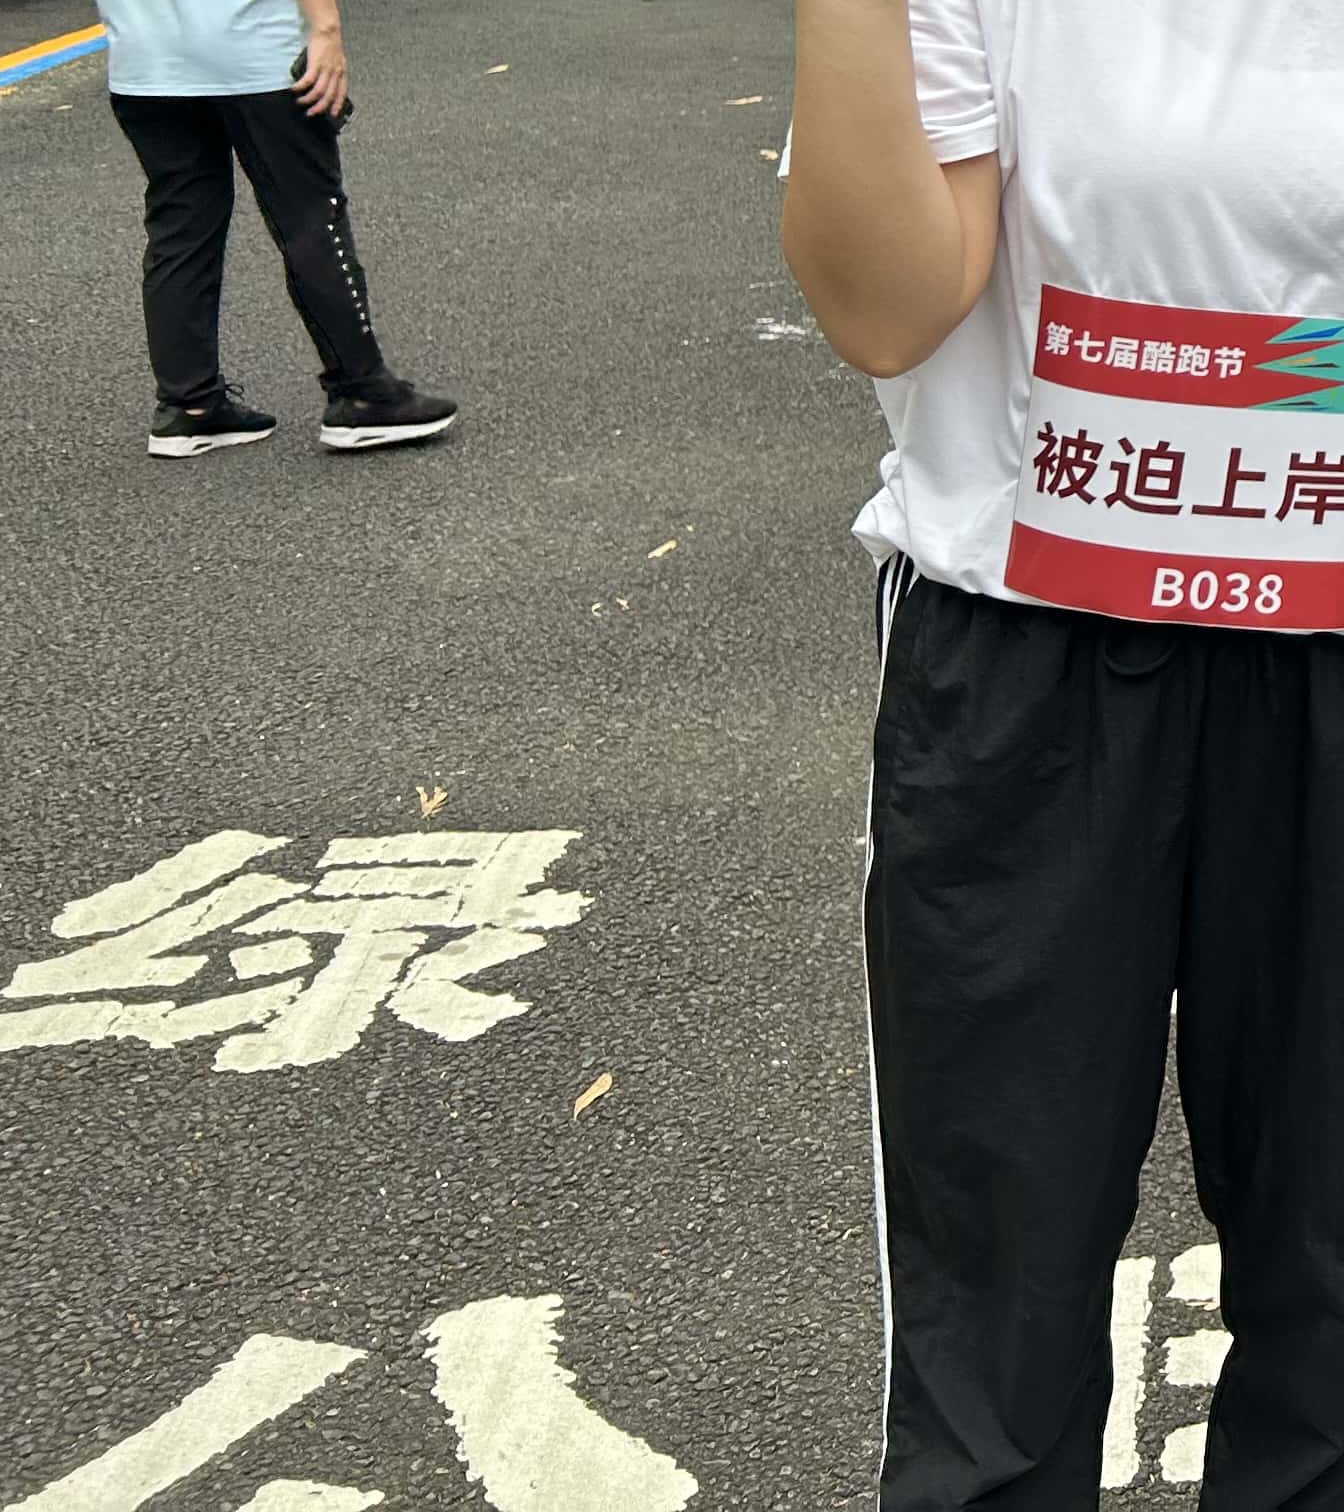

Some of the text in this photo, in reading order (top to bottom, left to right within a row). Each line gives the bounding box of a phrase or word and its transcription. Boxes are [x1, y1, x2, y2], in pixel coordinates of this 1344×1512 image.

[1044, 321, 1247, 379] 第七届酷跑节
[1151, 567, 1284, 615] B038
